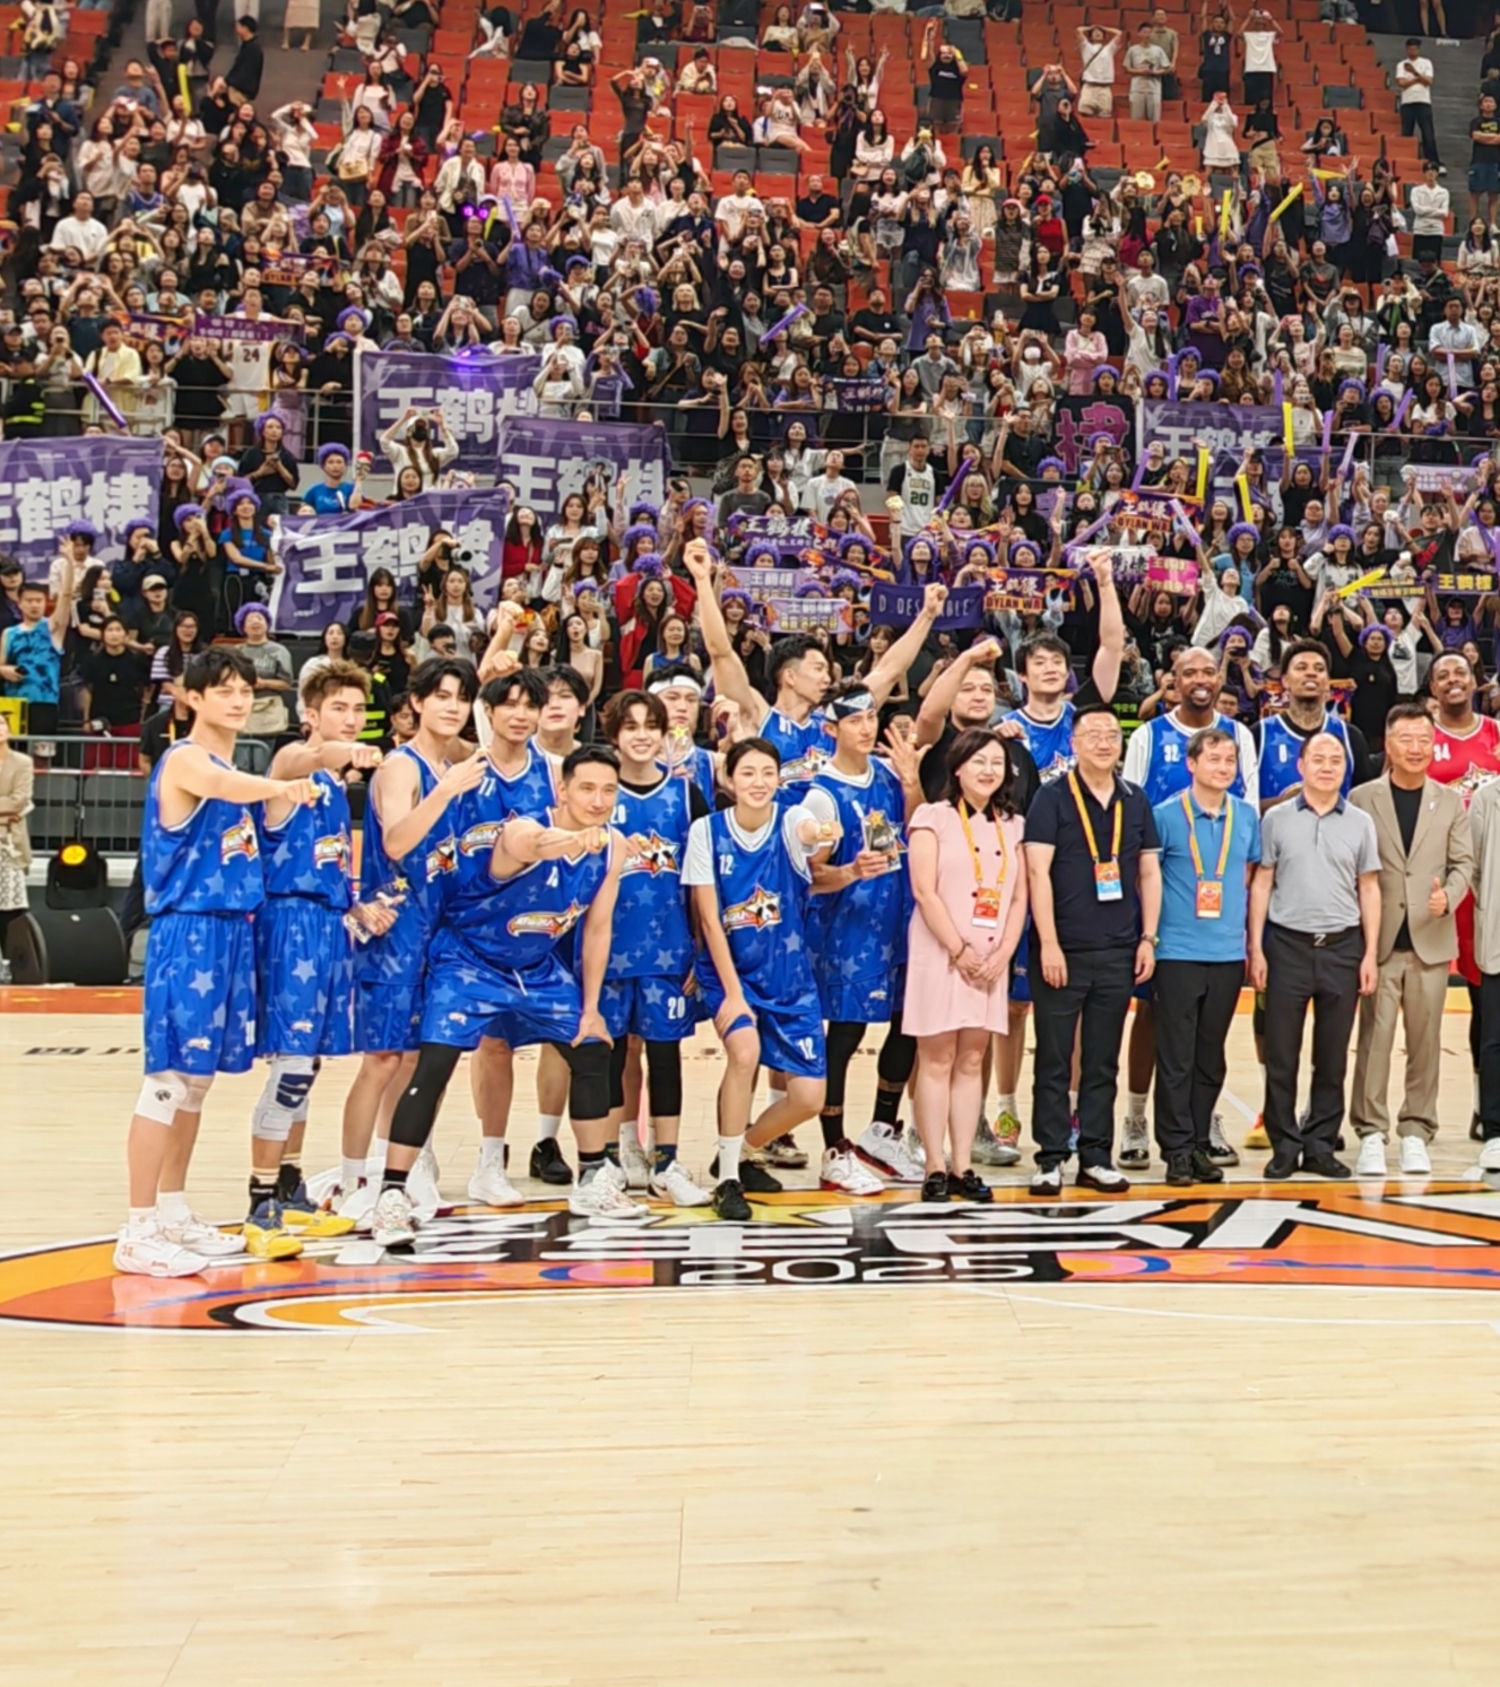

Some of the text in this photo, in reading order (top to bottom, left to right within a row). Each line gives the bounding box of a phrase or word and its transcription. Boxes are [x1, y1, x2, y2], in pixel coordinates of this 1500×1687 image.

[242, 348, 261, 364] 24
[910, 491, 929, 506] 20
[1163, 744, 1180, 763] 32
[1433, 742, 1452, 762] 34
[719, 854, 733, 876] 12
[667, 996, 686, 1020] 20
[795, 1036, 818, 1061] 12
[681, 1252, 1034, 1283] 2025
